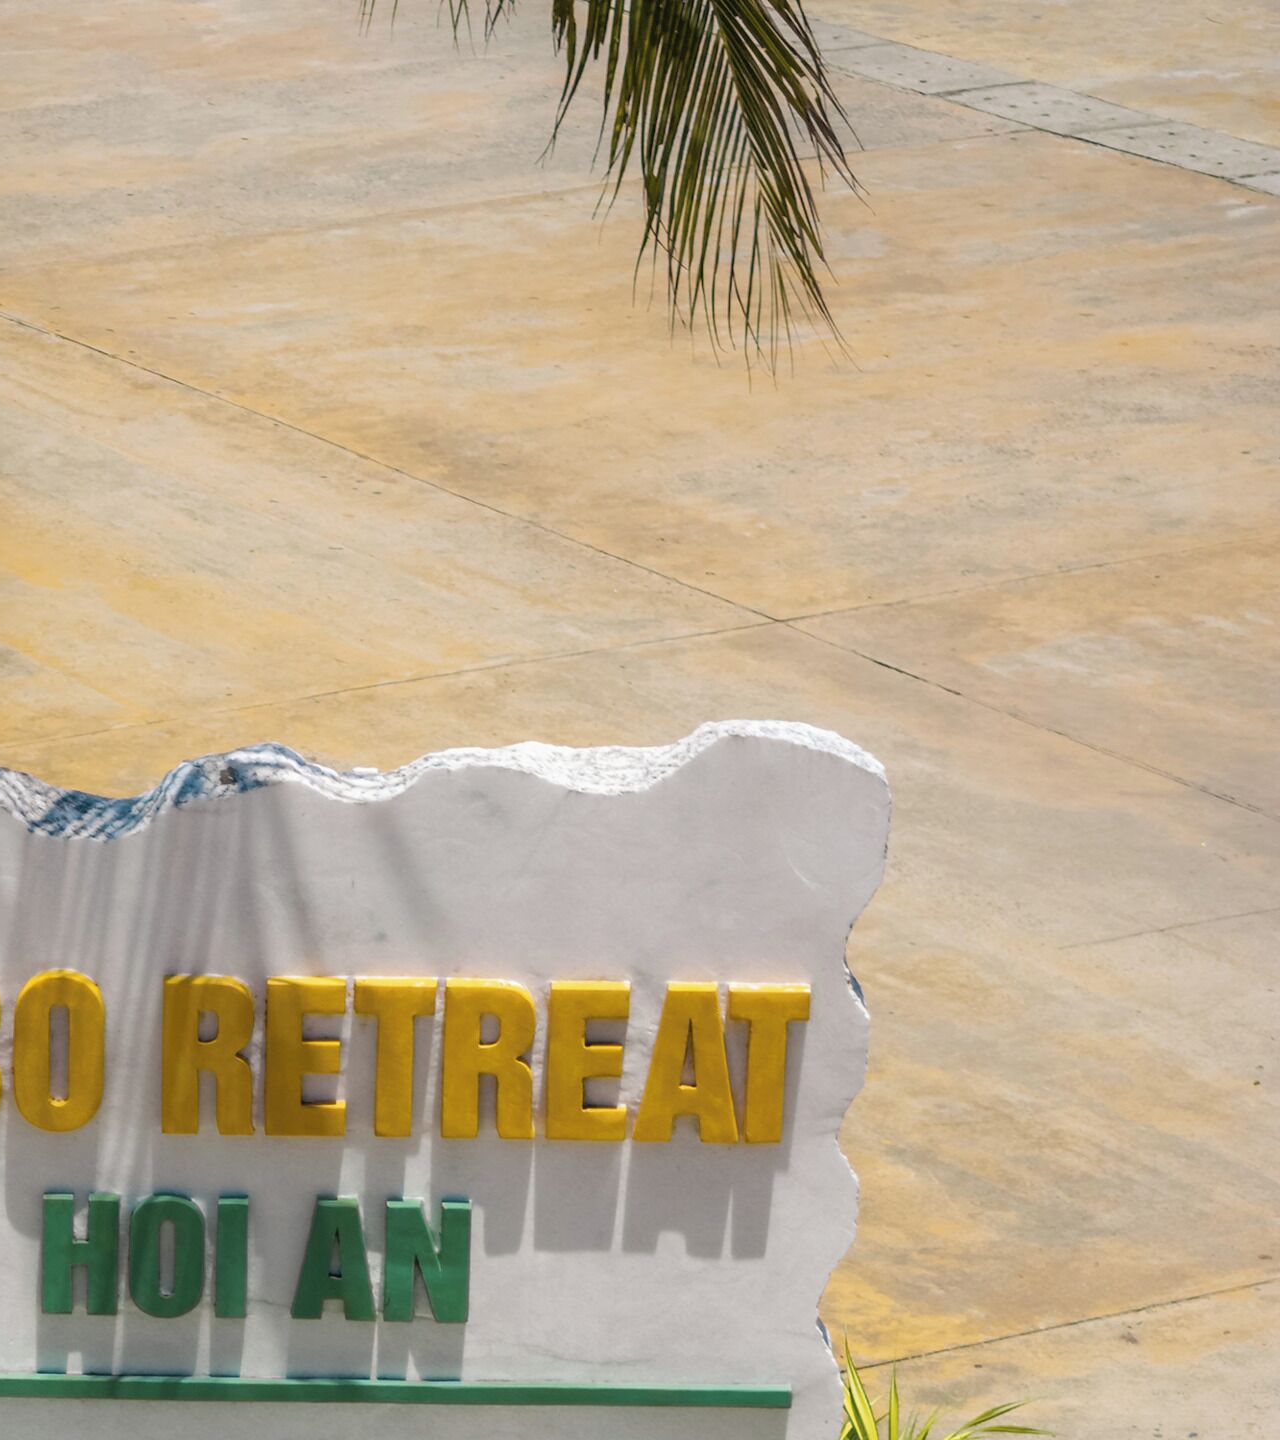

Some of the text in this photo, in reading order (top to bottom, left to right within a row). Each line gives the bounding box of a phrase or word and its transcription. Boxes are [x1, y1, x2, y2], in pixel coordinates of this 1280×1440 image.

[161, 973, 811, 1144] RETREAT
[42, 1192, 471, 1322] HOI AN
